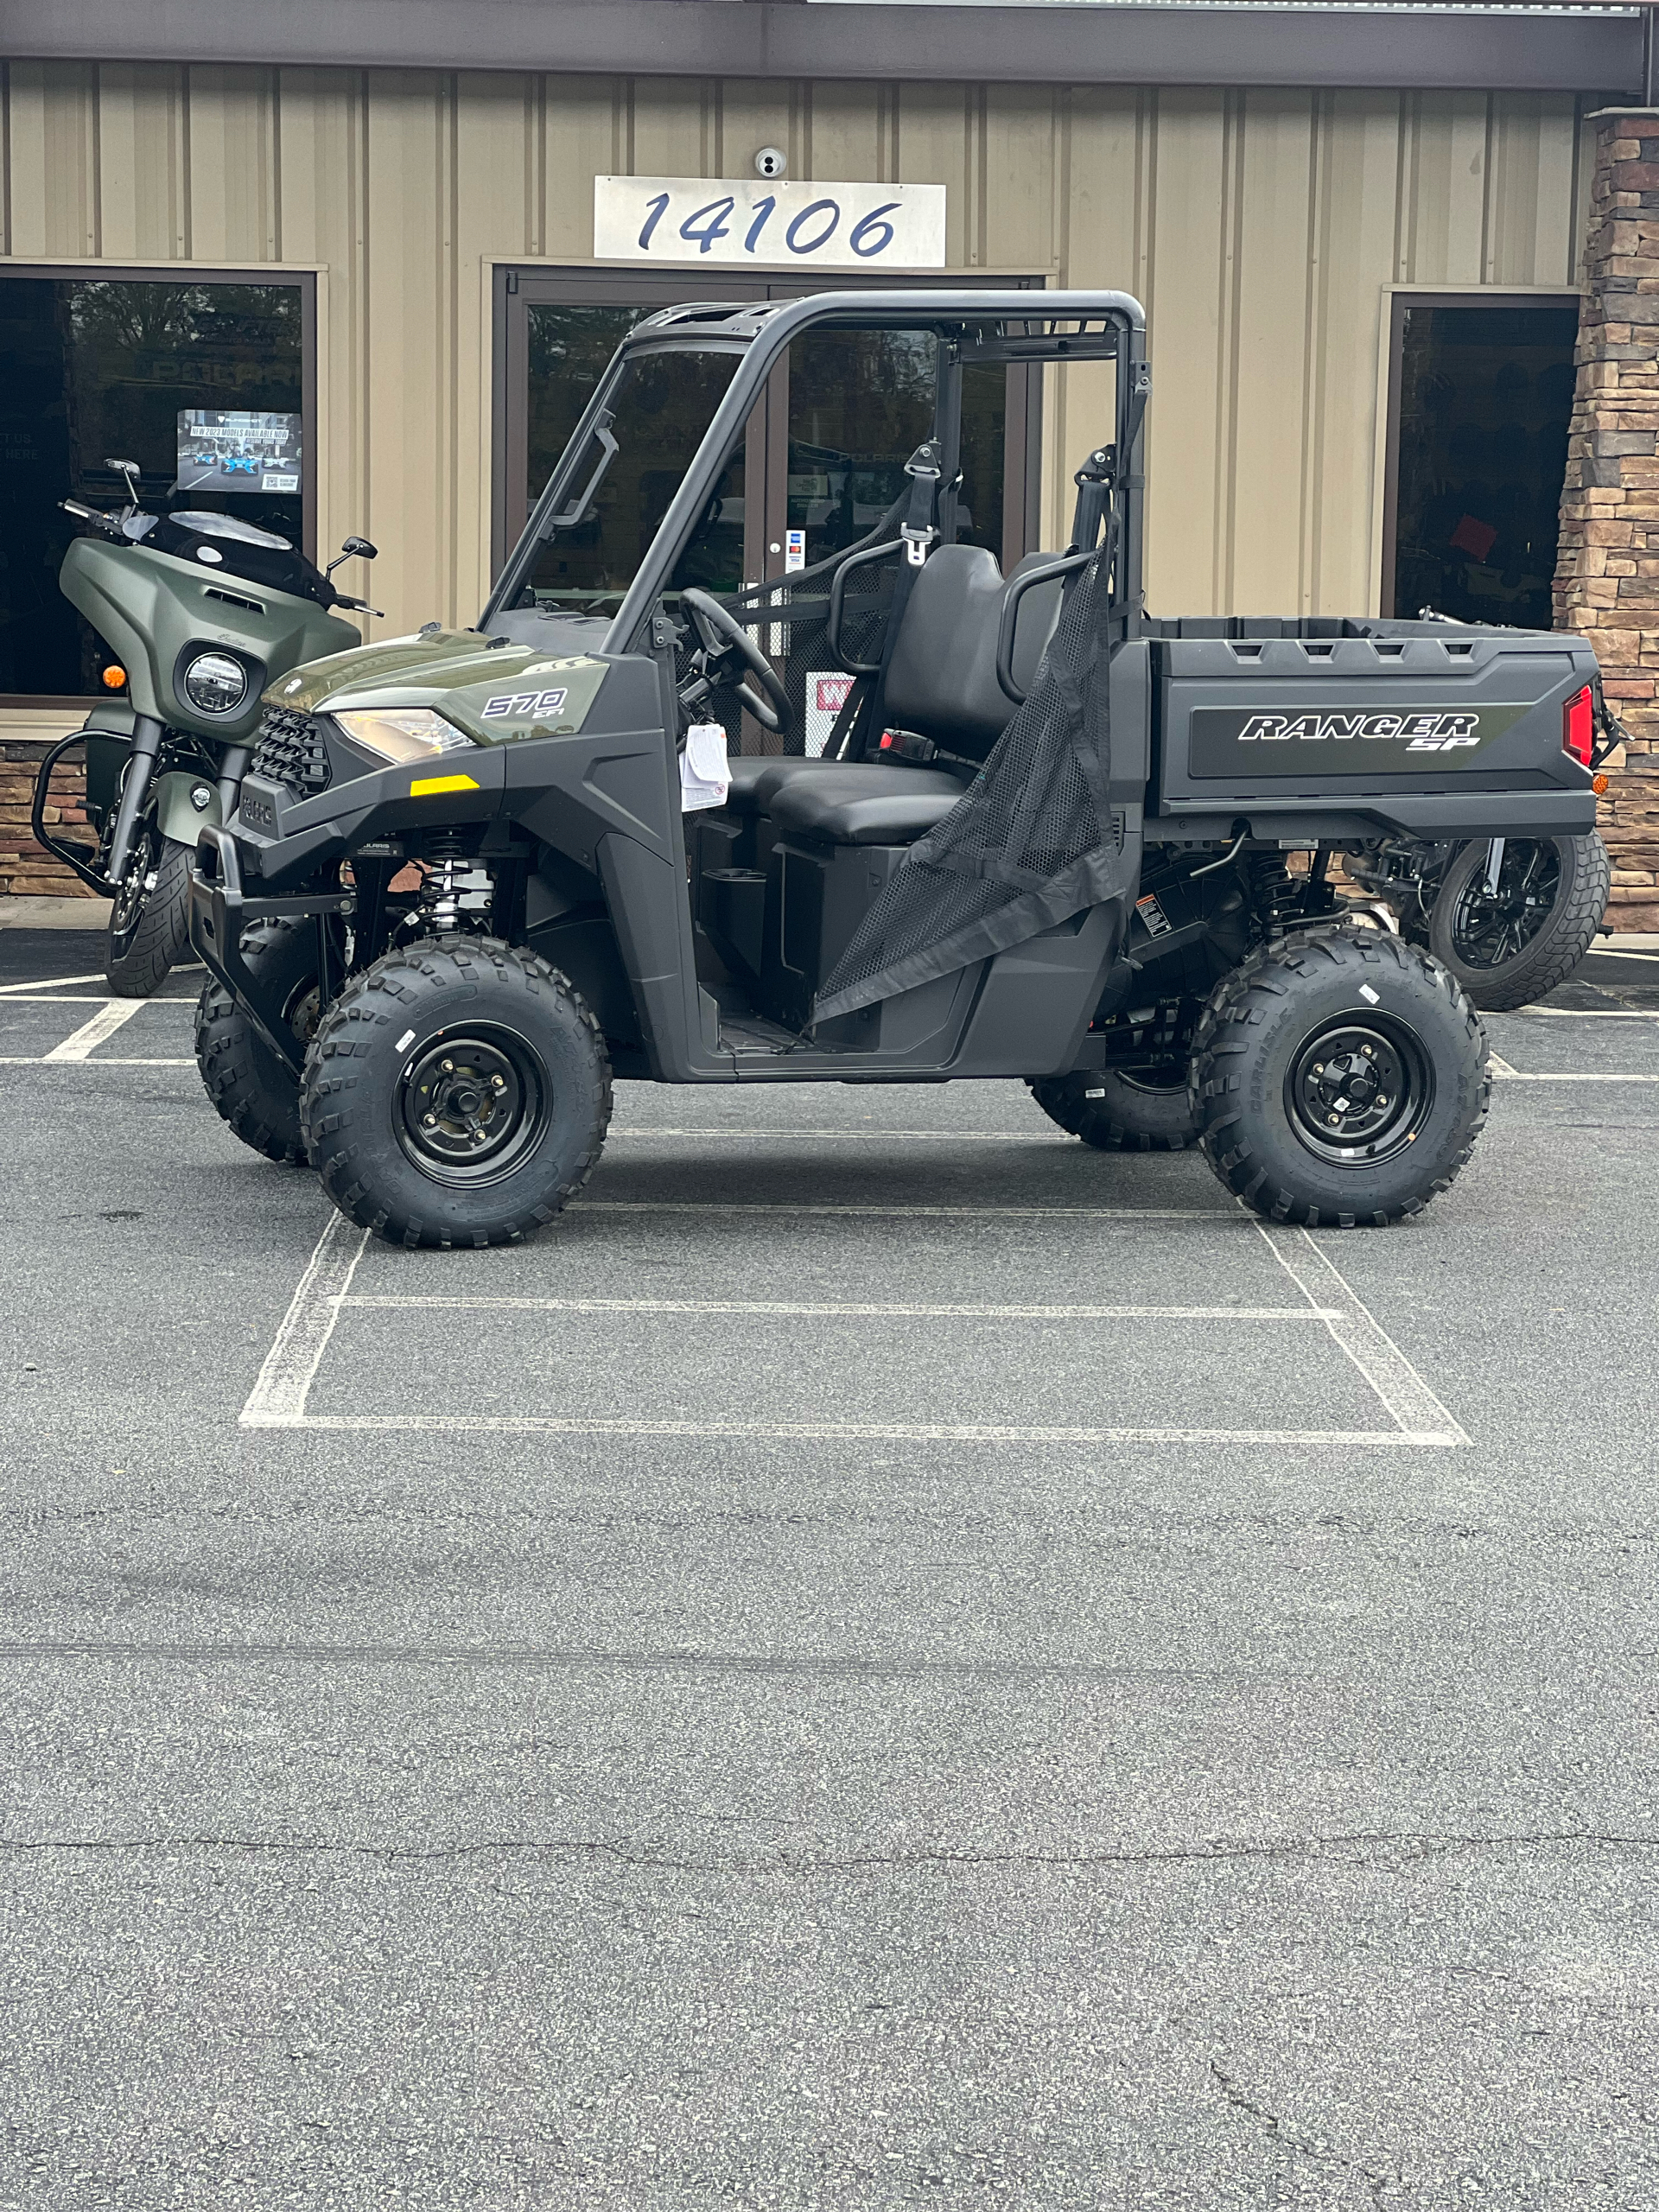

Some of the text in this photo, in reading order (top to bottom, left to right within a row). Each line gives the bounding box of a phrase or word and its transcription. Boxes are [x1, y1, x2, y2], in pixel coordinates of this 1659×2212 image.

[638, 192, 903, 257] 14106
[192, 427, 289, 439] NEW 2023 MODELS AVAILABLE NOW
[480, 687, 569, 719] 570
[532, 708, 565, 719] EFI
[1237, 714, 1480, 741] RANGER
[1405, 737, 1481, 751] SP
